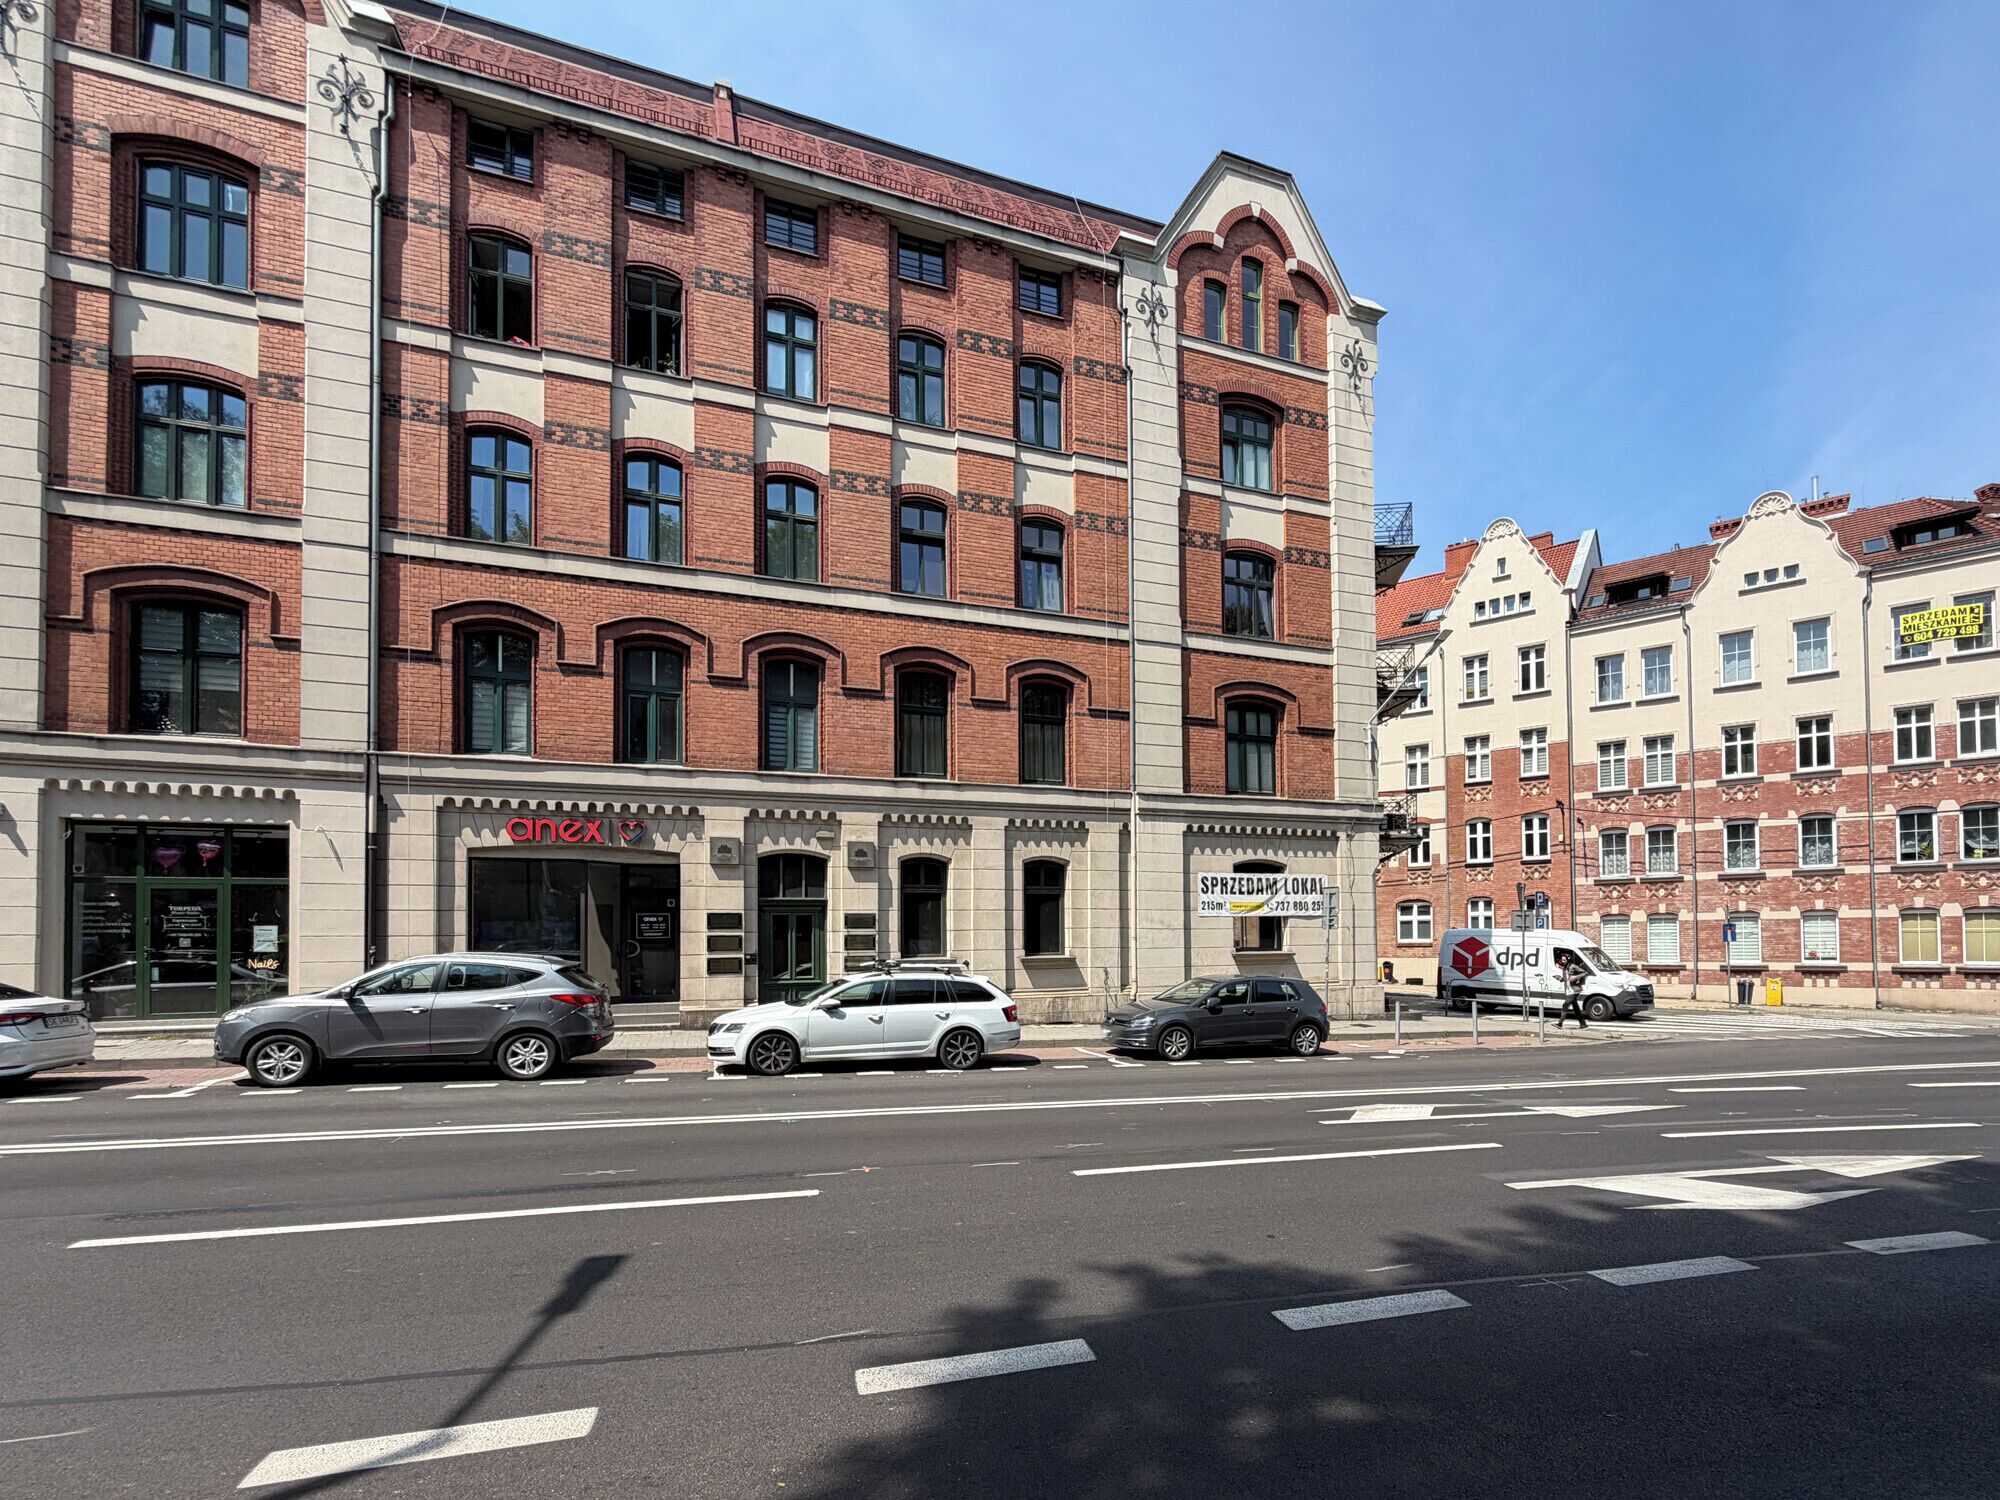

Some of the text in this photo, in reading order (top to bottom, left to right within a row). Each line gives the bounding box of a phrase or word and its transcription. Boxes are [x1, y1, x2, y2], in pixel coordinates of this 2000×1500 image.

[1902, 607, 1968, 625] SPRZEDAM
[1903, 615, 1968, 634] MIESZKANIE
[1913, 624, 1980, 642] 604 729 498
[506, 817, 605, 844] anex
[1200, 876, 1278, 896] SPRZEDAM
[1275, 901, 1290, 912] 737
[248, 958, 280, 970] Nails
[1496, 946, 1540, 970] dpd
